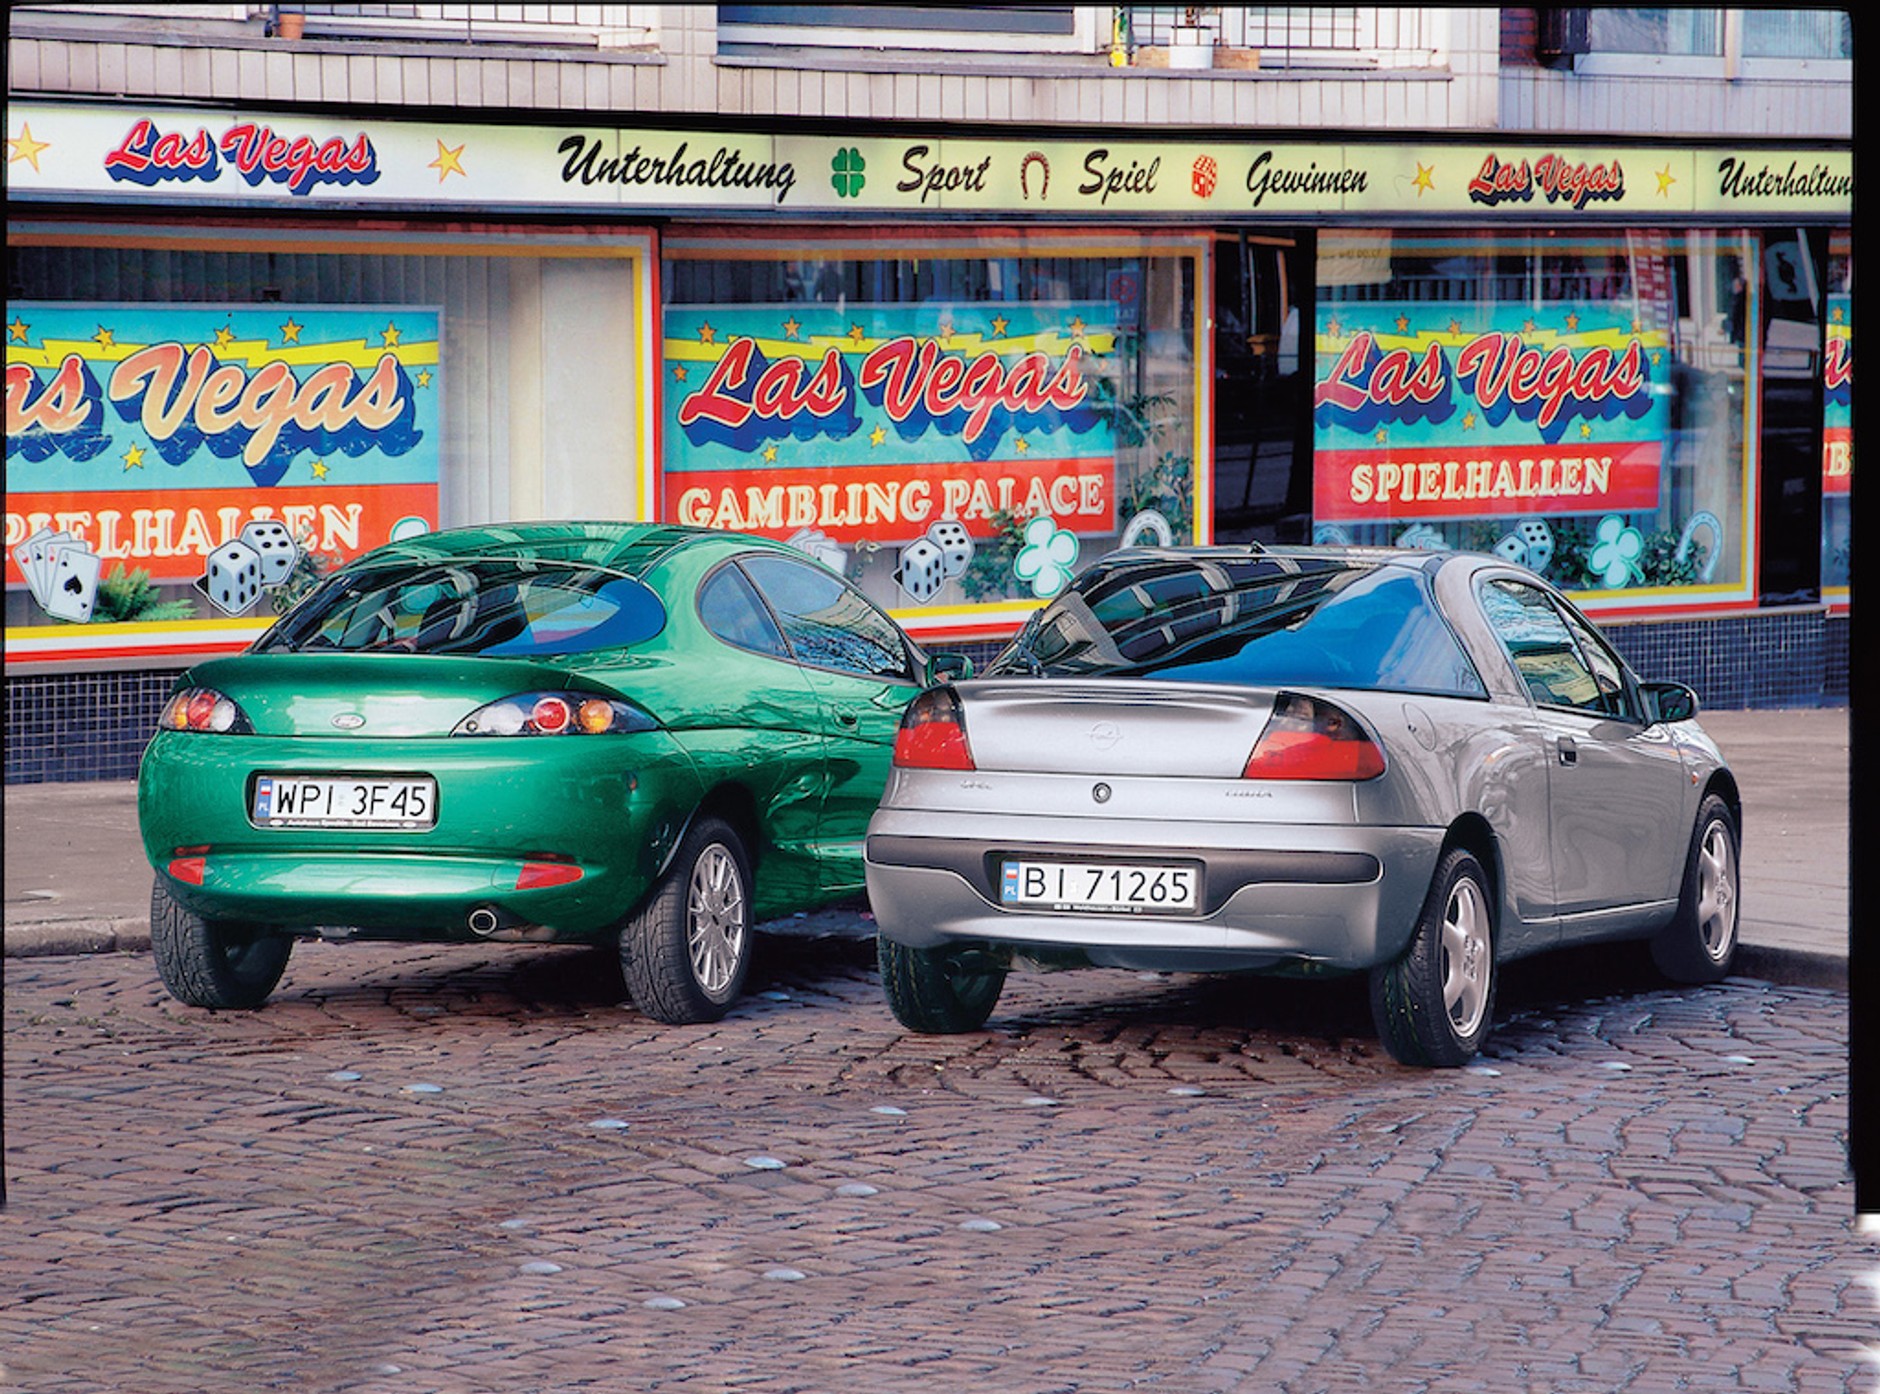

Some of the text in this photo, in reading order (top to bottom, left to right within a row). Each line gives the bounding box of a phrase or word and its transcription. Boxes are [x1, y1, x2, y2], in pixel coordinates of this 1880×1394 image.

[104, 118, 373, 190] Las Vegas
[557, 134, 797, 203] Unterhaltung
[896, 144, 992, 203] Sport
[1078, 149, 1159, 205] Spiel
[1245, 150, 1368, 205] Gewinnen
[1467, 152, 1623, 204] Las Vegas
[1718, 157, 1853, 198] Unterhaltun
[108, 341, 405, 467] Vegas
[679, 336, 1088, 444] Las Vegas
[1315, 331, 1644, 429] Las Vegas
[678, 475, 1105, 530] GAMBLING PALACE
[1350, 456, 1613, 503] SPIELHALLEN
[6, 504, 362, 561] PELHALEN
[276, 783, 427, 817] WPI 3F45
[1024, 866, 1189, 903] BI 71265
